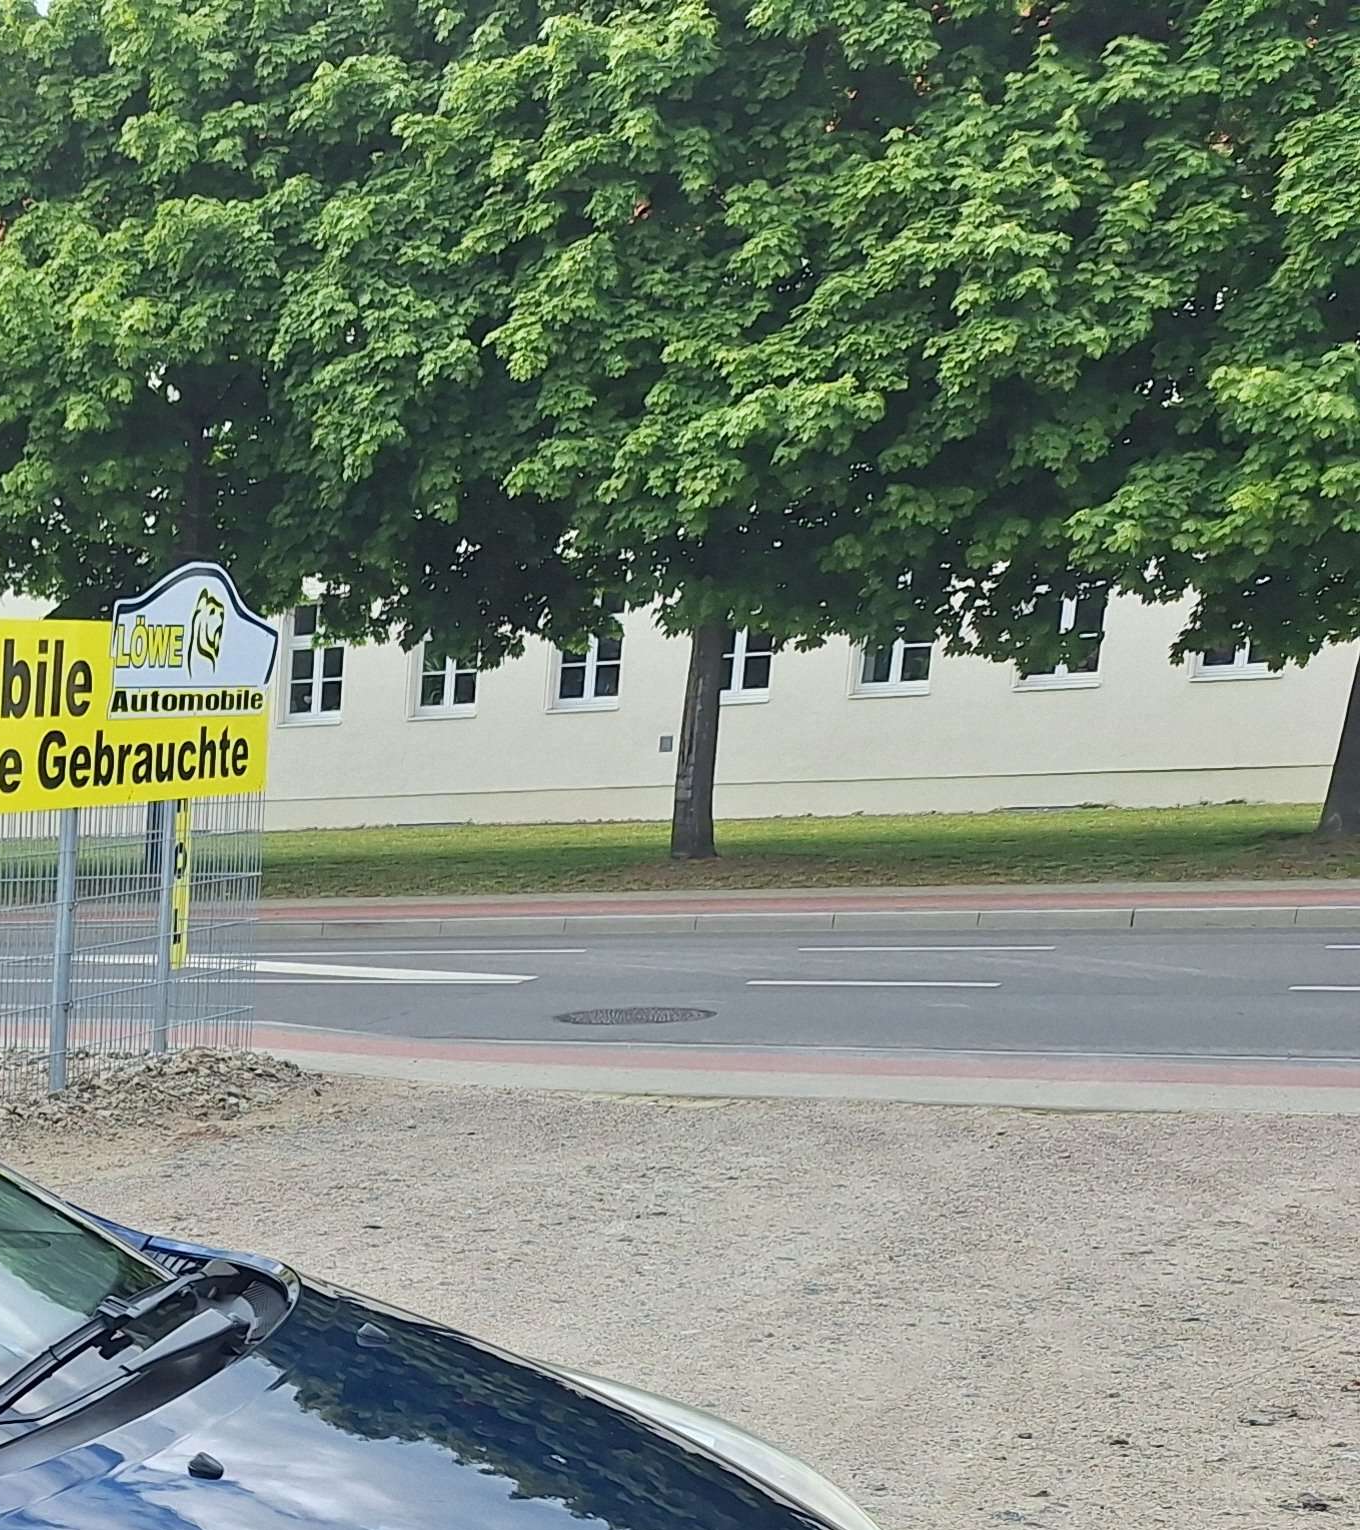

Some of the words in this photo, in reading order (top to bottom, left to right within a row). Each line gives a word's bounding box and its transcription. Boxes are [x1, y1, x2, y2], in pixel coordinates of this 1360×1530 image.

[116, 615, 184, 668] LÖWE
[110, 689, 264, 713] Automobile
[37, 725, 249, 791] Gebrauchte
